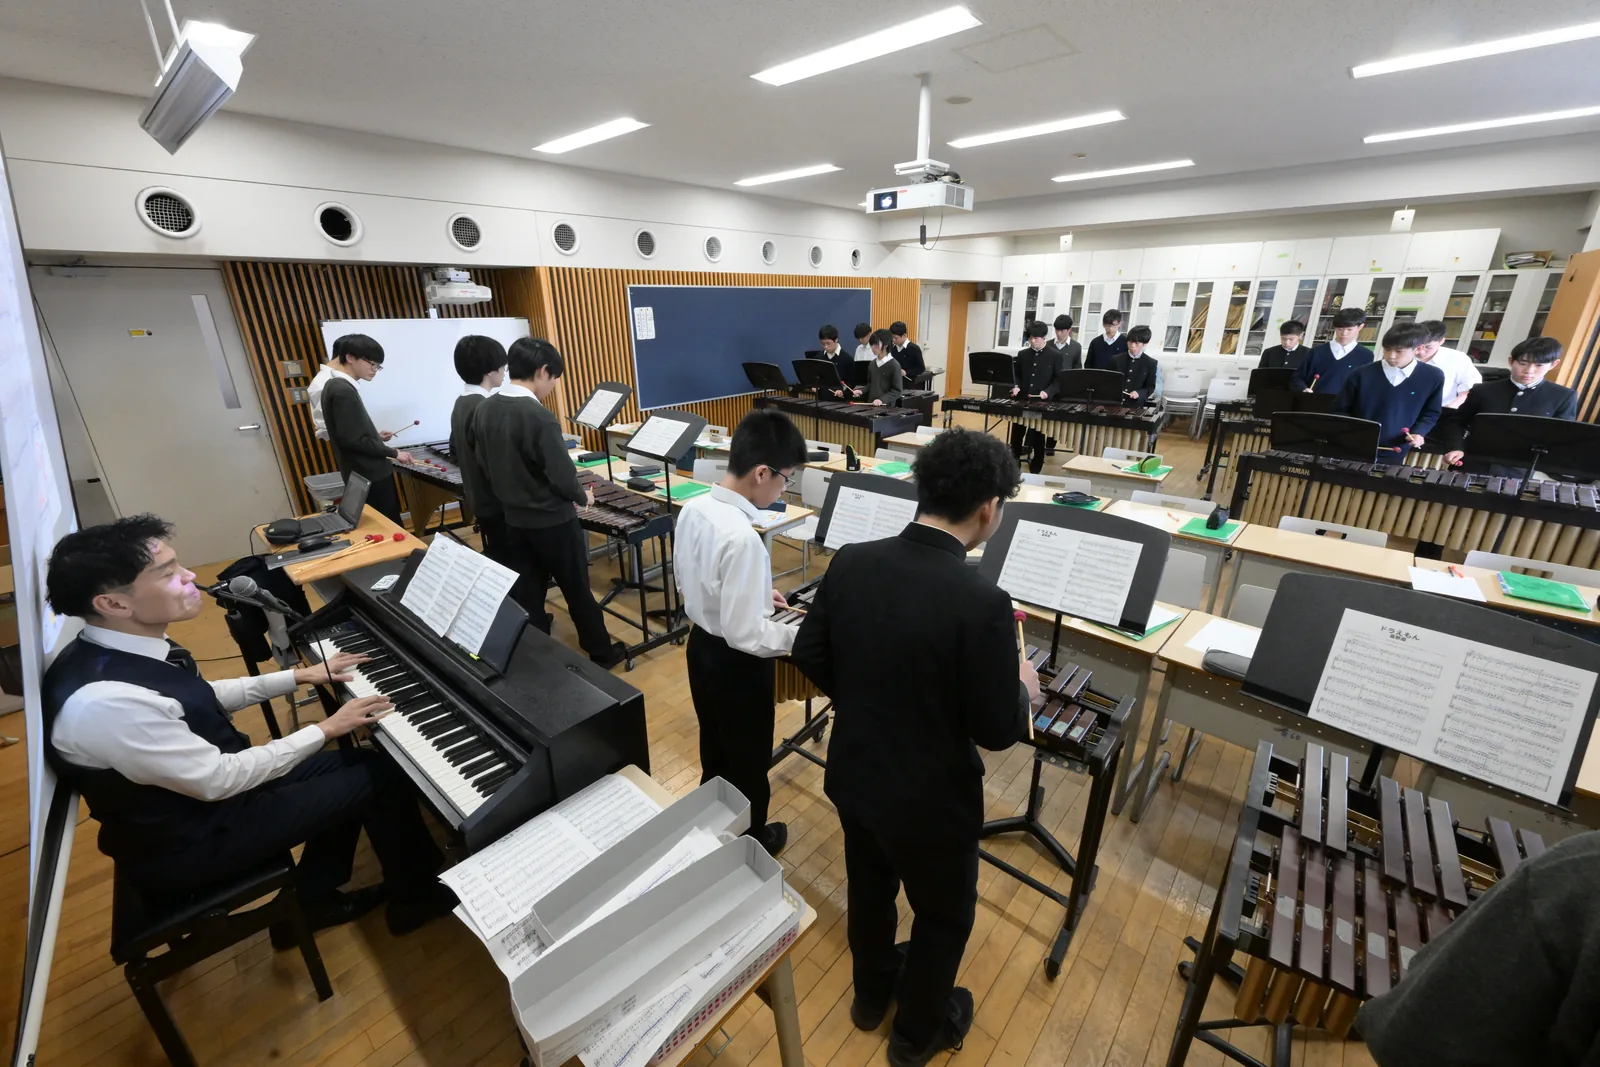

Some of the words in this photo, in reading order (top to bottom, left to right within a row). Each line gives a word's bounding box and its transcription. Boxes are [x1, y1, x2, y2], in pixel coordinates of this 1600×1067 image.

[1380, 625, 1420, 641] ドラえもん
